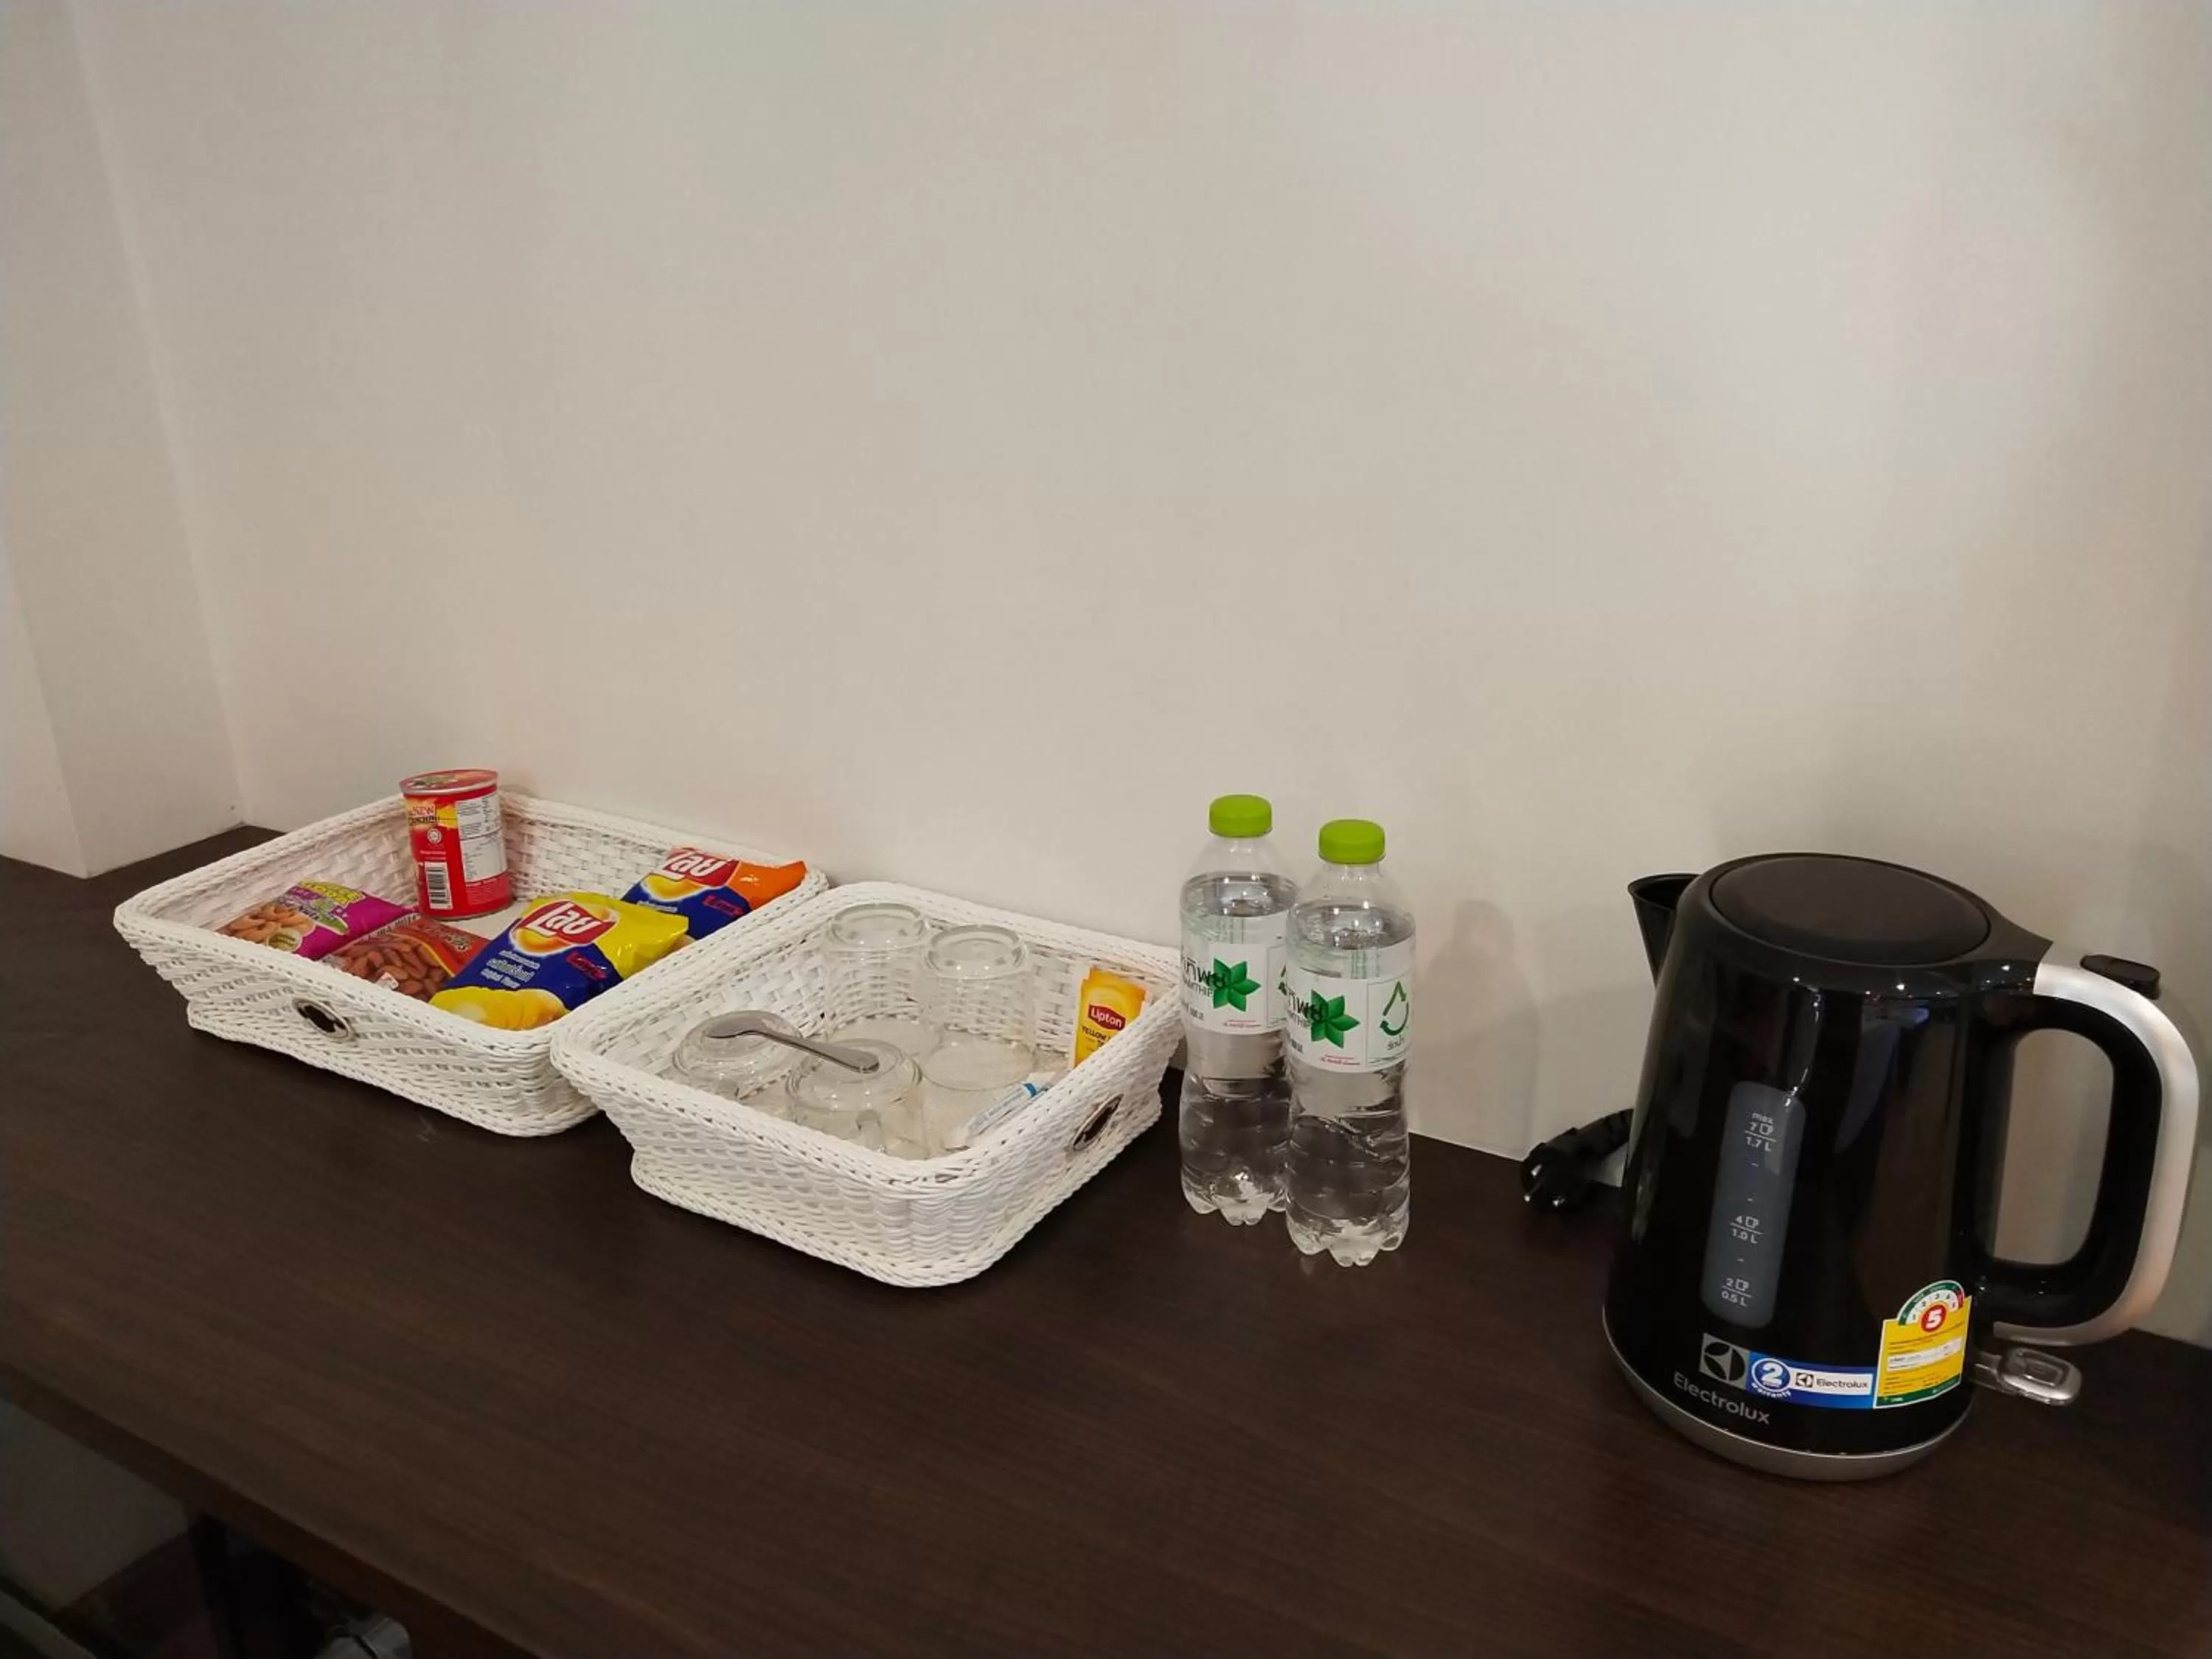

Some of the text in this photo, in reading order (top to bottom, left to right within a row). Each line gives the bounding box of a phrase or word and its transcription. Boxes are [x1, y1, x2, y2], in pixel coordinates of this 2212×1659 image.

[1091, 1007, 1121, 1029] Lipton
[1082, 1026, 1107, 1042] YELLOW
[1751, 1111, 1773, 1124] max
[1925, 1309, 1943, 1329] 5
[1761, 1363, 1784, 1385] 2
[1816, 1378, 1868, 1389] Electrolux
[1674, 1371, 1770, 1426] Electrolux
